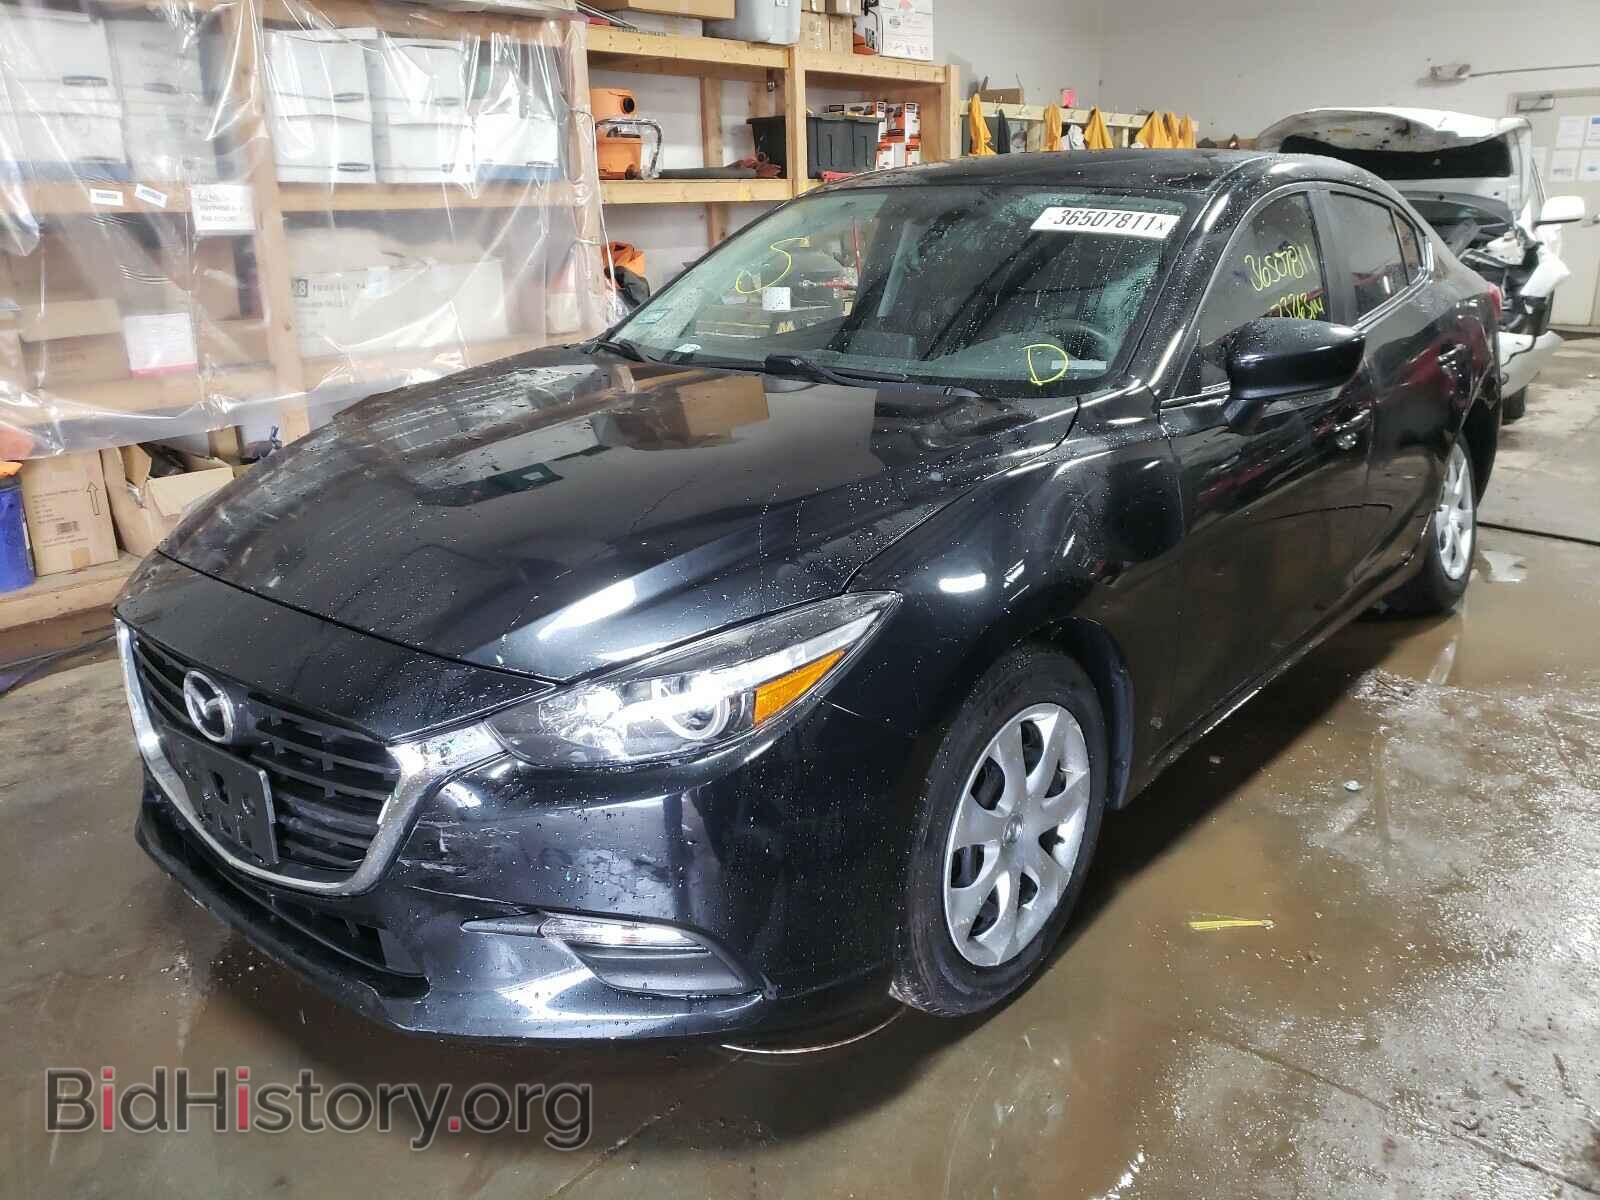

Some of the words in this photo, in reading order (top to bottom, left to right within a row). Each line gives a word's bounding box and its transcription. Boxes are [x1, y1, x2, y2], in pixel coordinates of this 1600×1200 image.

[1054, 209, 1157, 230] 36507811
[1244, 243, 1317, 291] 36507811
[1023, 343, 1069, 386] D
